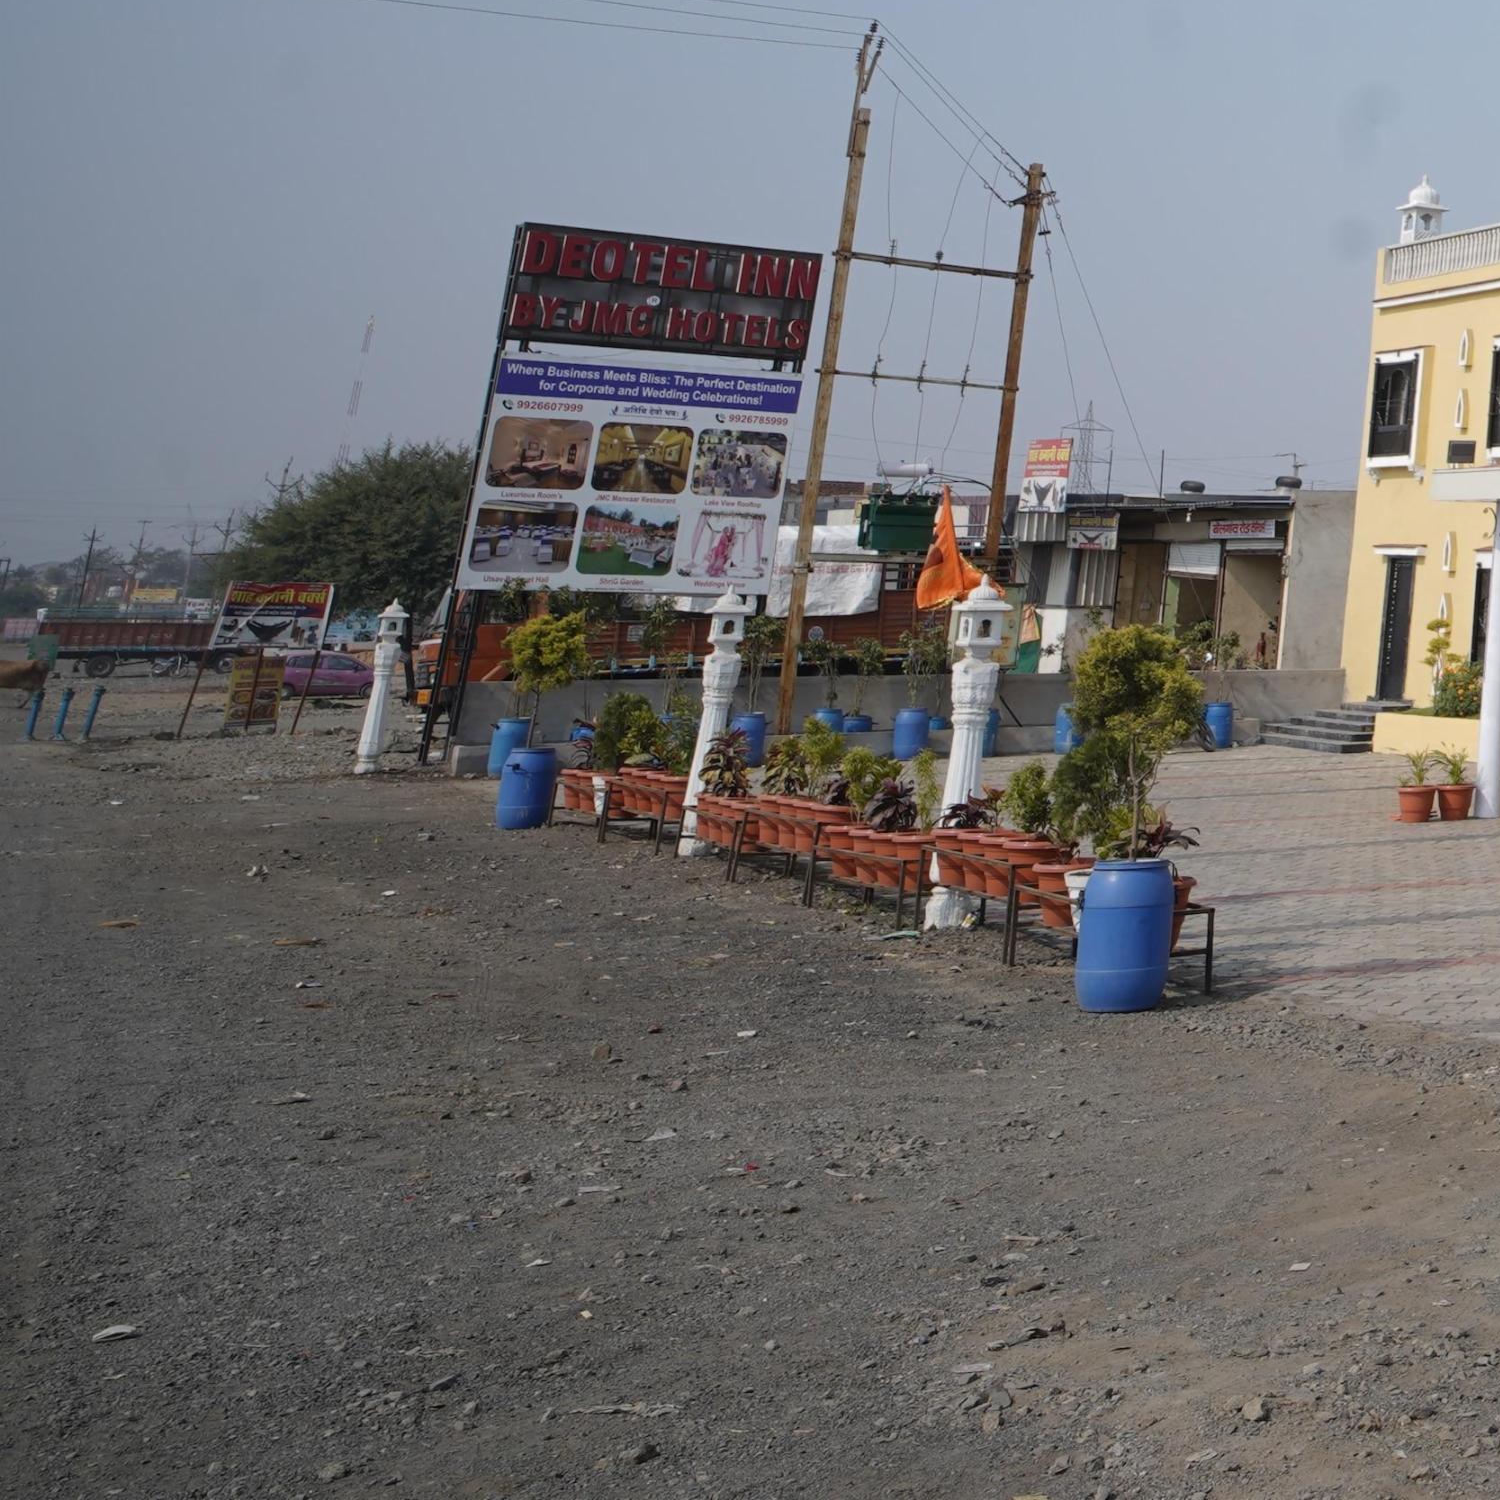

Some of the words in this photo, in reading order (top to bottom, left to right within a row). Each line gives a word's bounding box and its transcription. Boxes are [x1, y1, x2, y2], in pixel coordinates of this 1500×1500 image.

[520, 229, 716, 290] DEOTEL
[736, 253, 821, 300] INN
[509, 293, 558, 329] BY
[569, 299, 655, 338] JMC
[665, 307, 808, 351] HOTELS
[507, 363, 545, 377] Where
[547, 366, 600, 380] Business
[603, 370, 637, 383] Meets
[639, 373, 671, 386] Bliss:
[674, 375, 694, 387] The
[696, 377, 735, 391] Perfect
[737, 380, 796, 395] Destination
[539, 380, 555, 391] for
[558, 381, 615, 397] Corporate
[618, 385, 639, 397] and
[642, 386, 690, 402] Wedding
[692, 389, 763, 405] Celebrations!
[516, 400, 584, 413] 9926607999
[728, 413, 789, 426] 9926785999
